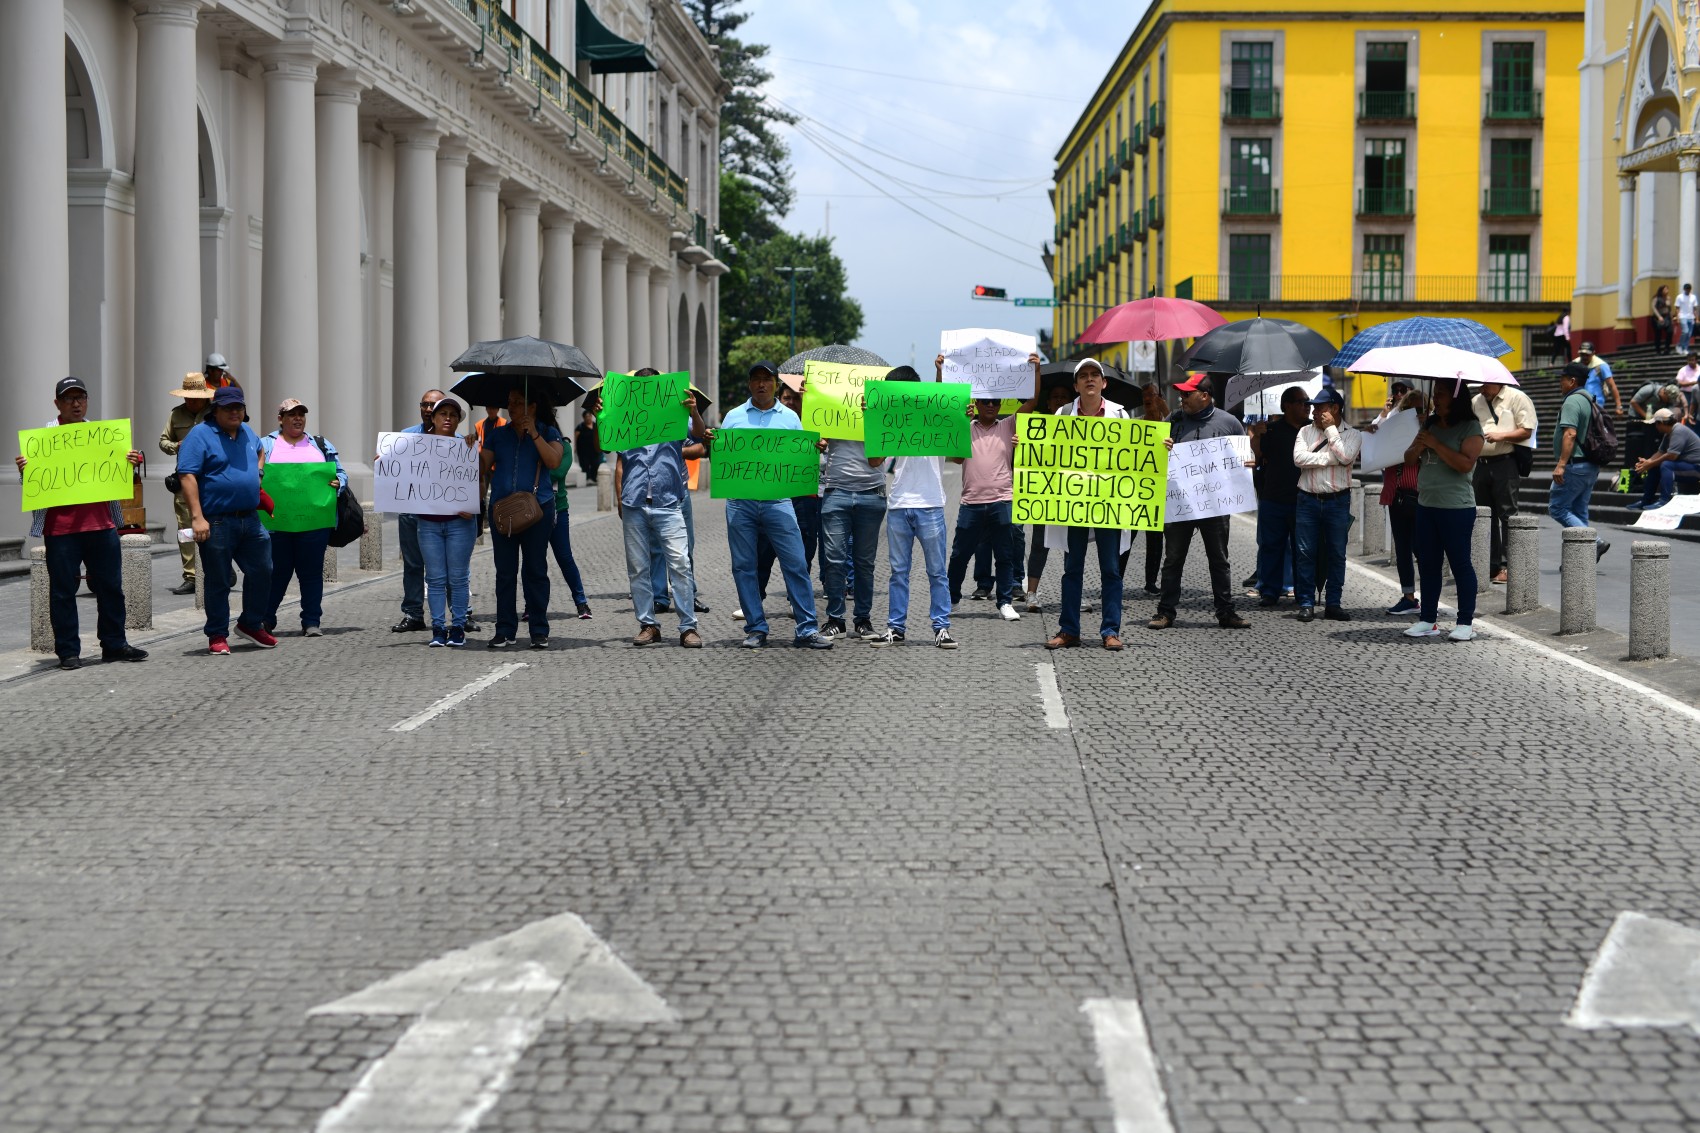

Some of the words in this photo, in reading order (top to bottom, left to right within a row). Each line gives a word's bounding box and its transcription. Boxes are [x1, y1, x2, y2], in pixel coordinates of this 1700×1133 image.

[975, 347, 1018, 358] ESTADO
[805, 364, 843, 385] ESTE
[945, 363, 959, 373] NO
[962, 362, 1003, 374] CUMPLE
[1009, 362, 1034, 373] LOS
[604, 377, 682, 410] MORENA
[842, 391, 865, 408] NO
[866, 387, 961, 412] QUEREMOS
[622, 410, 648, 425] NO
[812, 407, 864, 429] CUMP
[882, 412, 915, 429] QUE
[923, 413, 954, 428] NOS
[26, 426, 125, 458] QUEREMOS
[881, 431, 960, 452] PAGUEN
[1052, 418, 1122, 444] AÑOS
[1129, 423, 1157, 447] DE
[380, 434, 478, 463] GOBIERNO
[750, 435, 787, 454] QUE
[378, 460, 401, 478] NO
[411, 461, 430, 478] HA
[1020, 443, 1159, 474] INJUSTICIA
[26, 450, 129, 498] SOLUCIÓN
[1181, 461, 1218, 478] TENIA
[394, 482, 469, 502] LAUDOS
[1019, 471, 1156, 501] !EXIGIMOS
[1193, 481, 1221, 496] PAGO
[1016, 498, 1122, 526] SOLUCIÓN
[1174, 504, 1194, 517] 23
[1197, 500, 1213, 512] DE
[1217, 494, 1244, 508] MAYO
